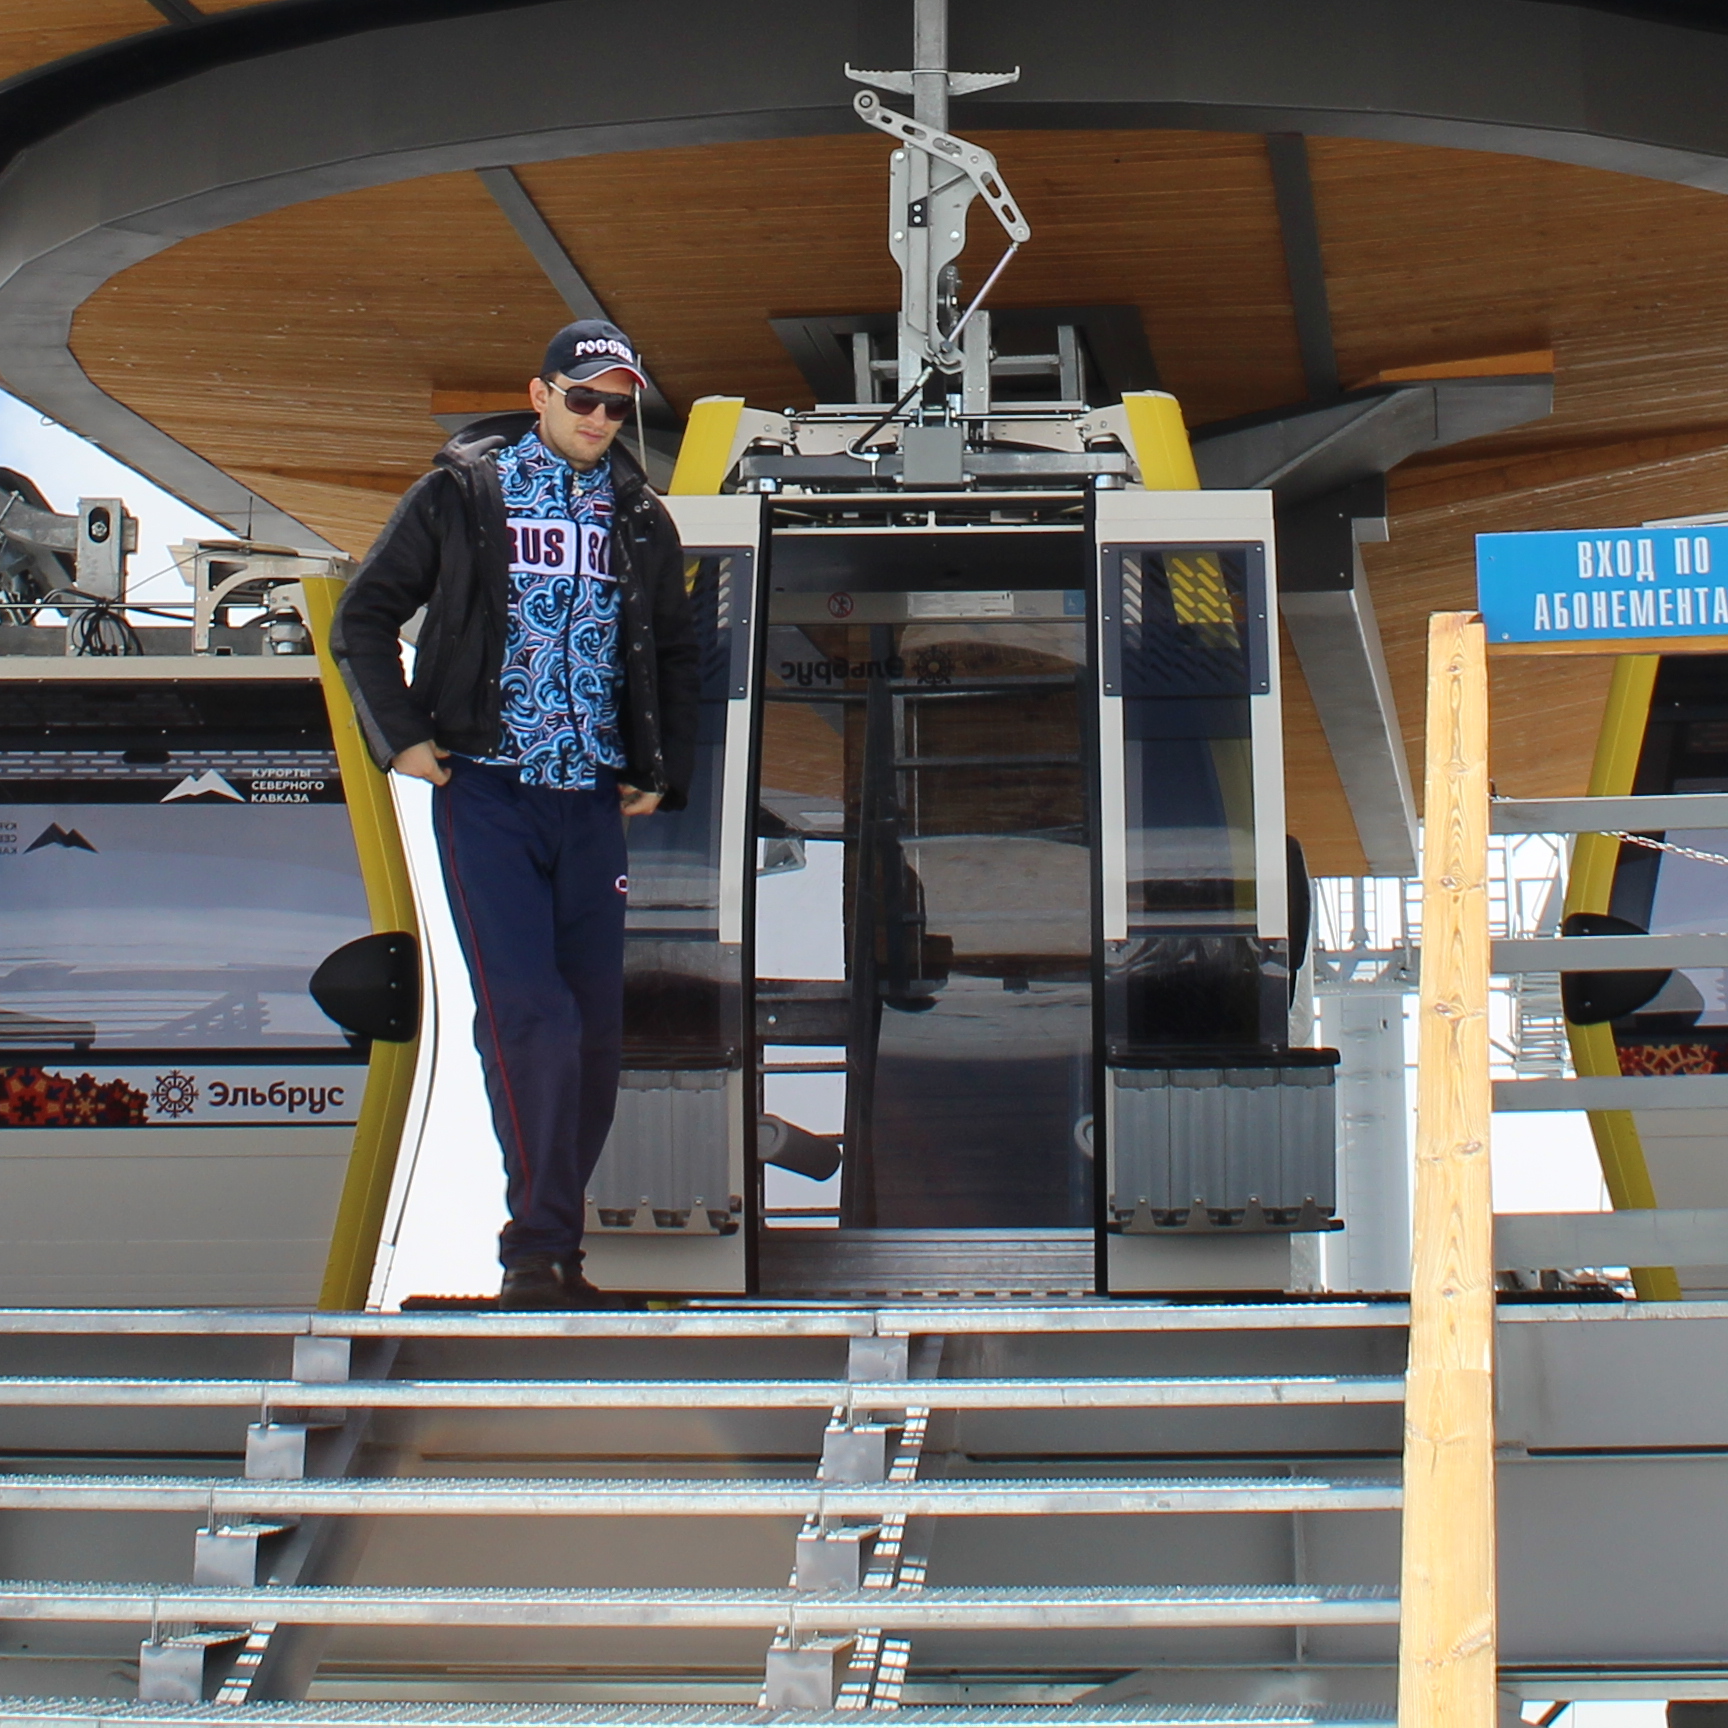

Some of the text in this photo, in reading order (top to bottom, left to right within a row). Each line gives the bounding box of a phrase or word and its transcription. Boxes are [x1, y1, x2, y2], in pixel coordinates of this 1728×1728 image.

[1576, 536, 1711, 582] ВХОД ПО
[251, 767, 312, 778] КУРОРТЫ
[251, 780, 325, 791] СЕВЕРНОГО
[251, 793, 310, 803] КАВКАЗА
[207, 1080, 345, 1114] Эльбрус
